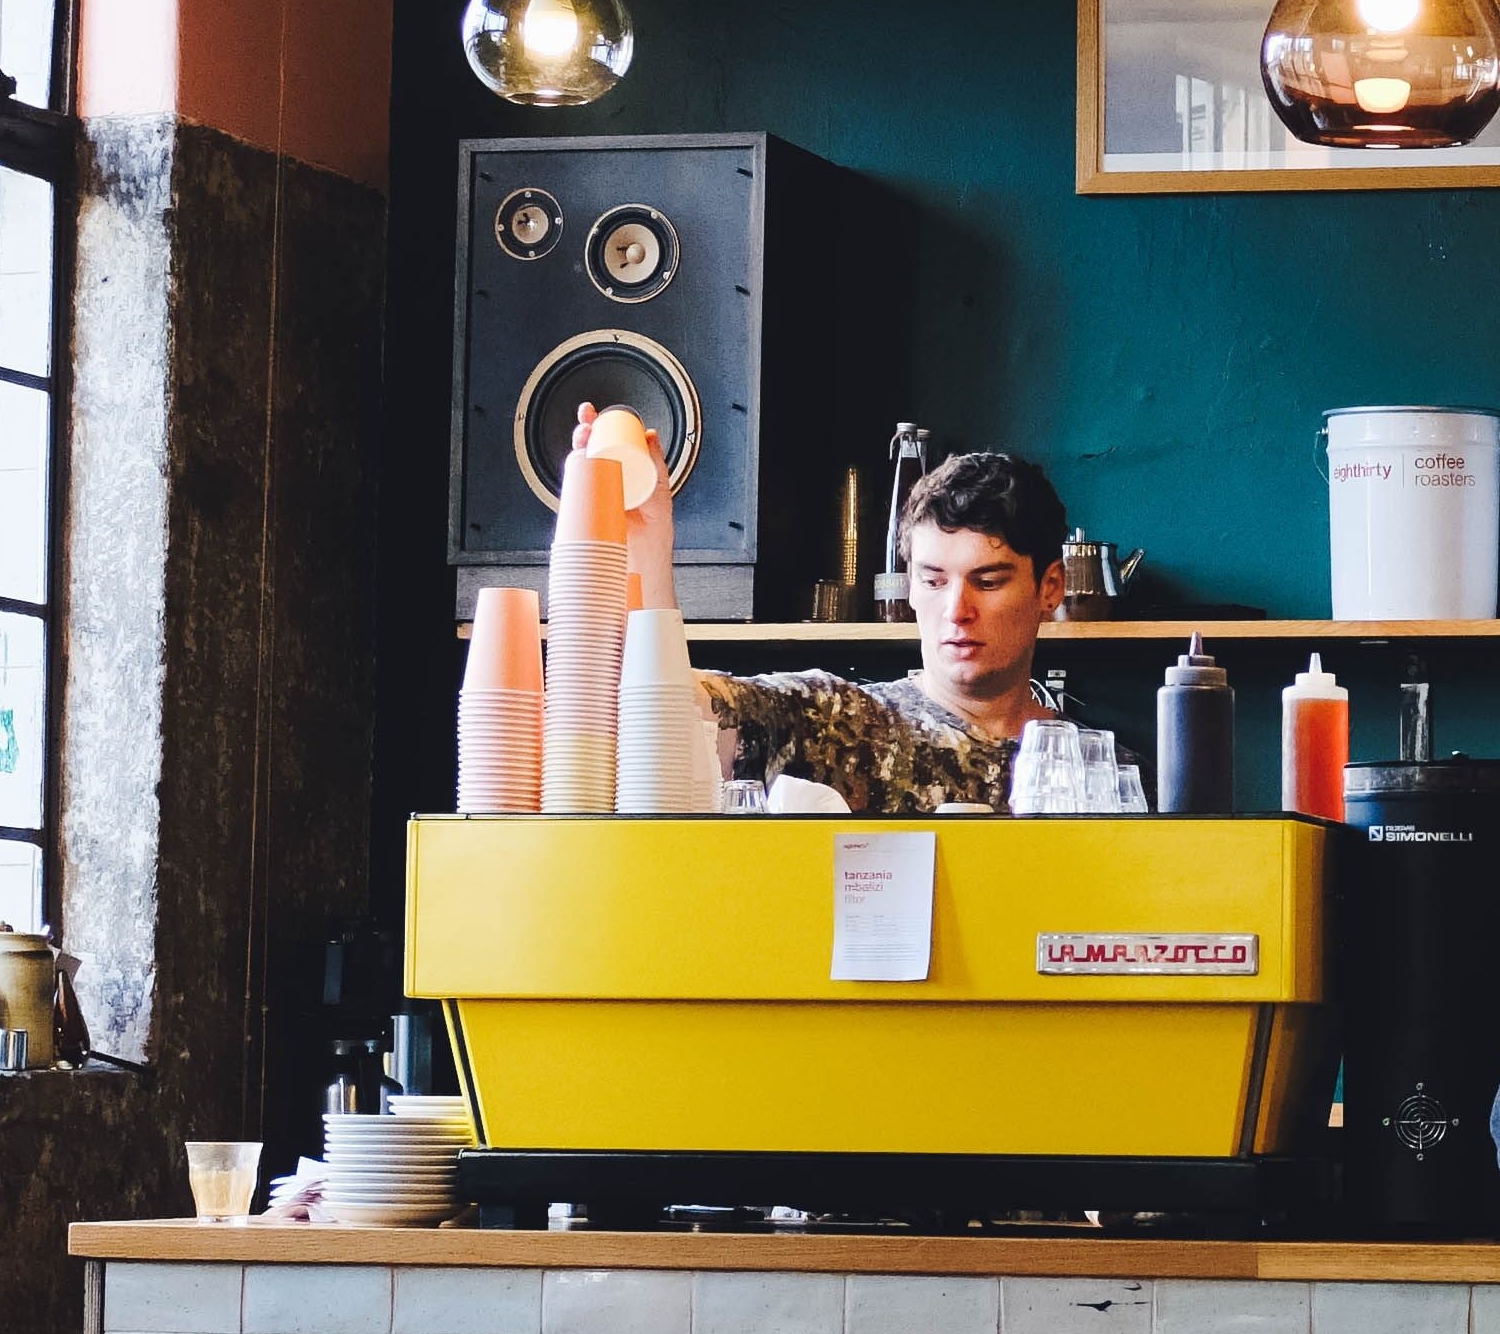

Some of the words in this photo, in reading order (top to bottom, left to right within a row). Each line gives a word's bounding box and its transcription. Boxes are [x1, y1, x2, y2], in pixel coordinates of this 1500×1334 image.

[1414, 453, 1465, 469] coffee
[1334, 462, 1392, 483] eighthirty
[1414, 473, 1476, 487] roasters
[1385, 832, 1473, 842] SIMONELLI
[844, 870, 893, 881] tanzania
